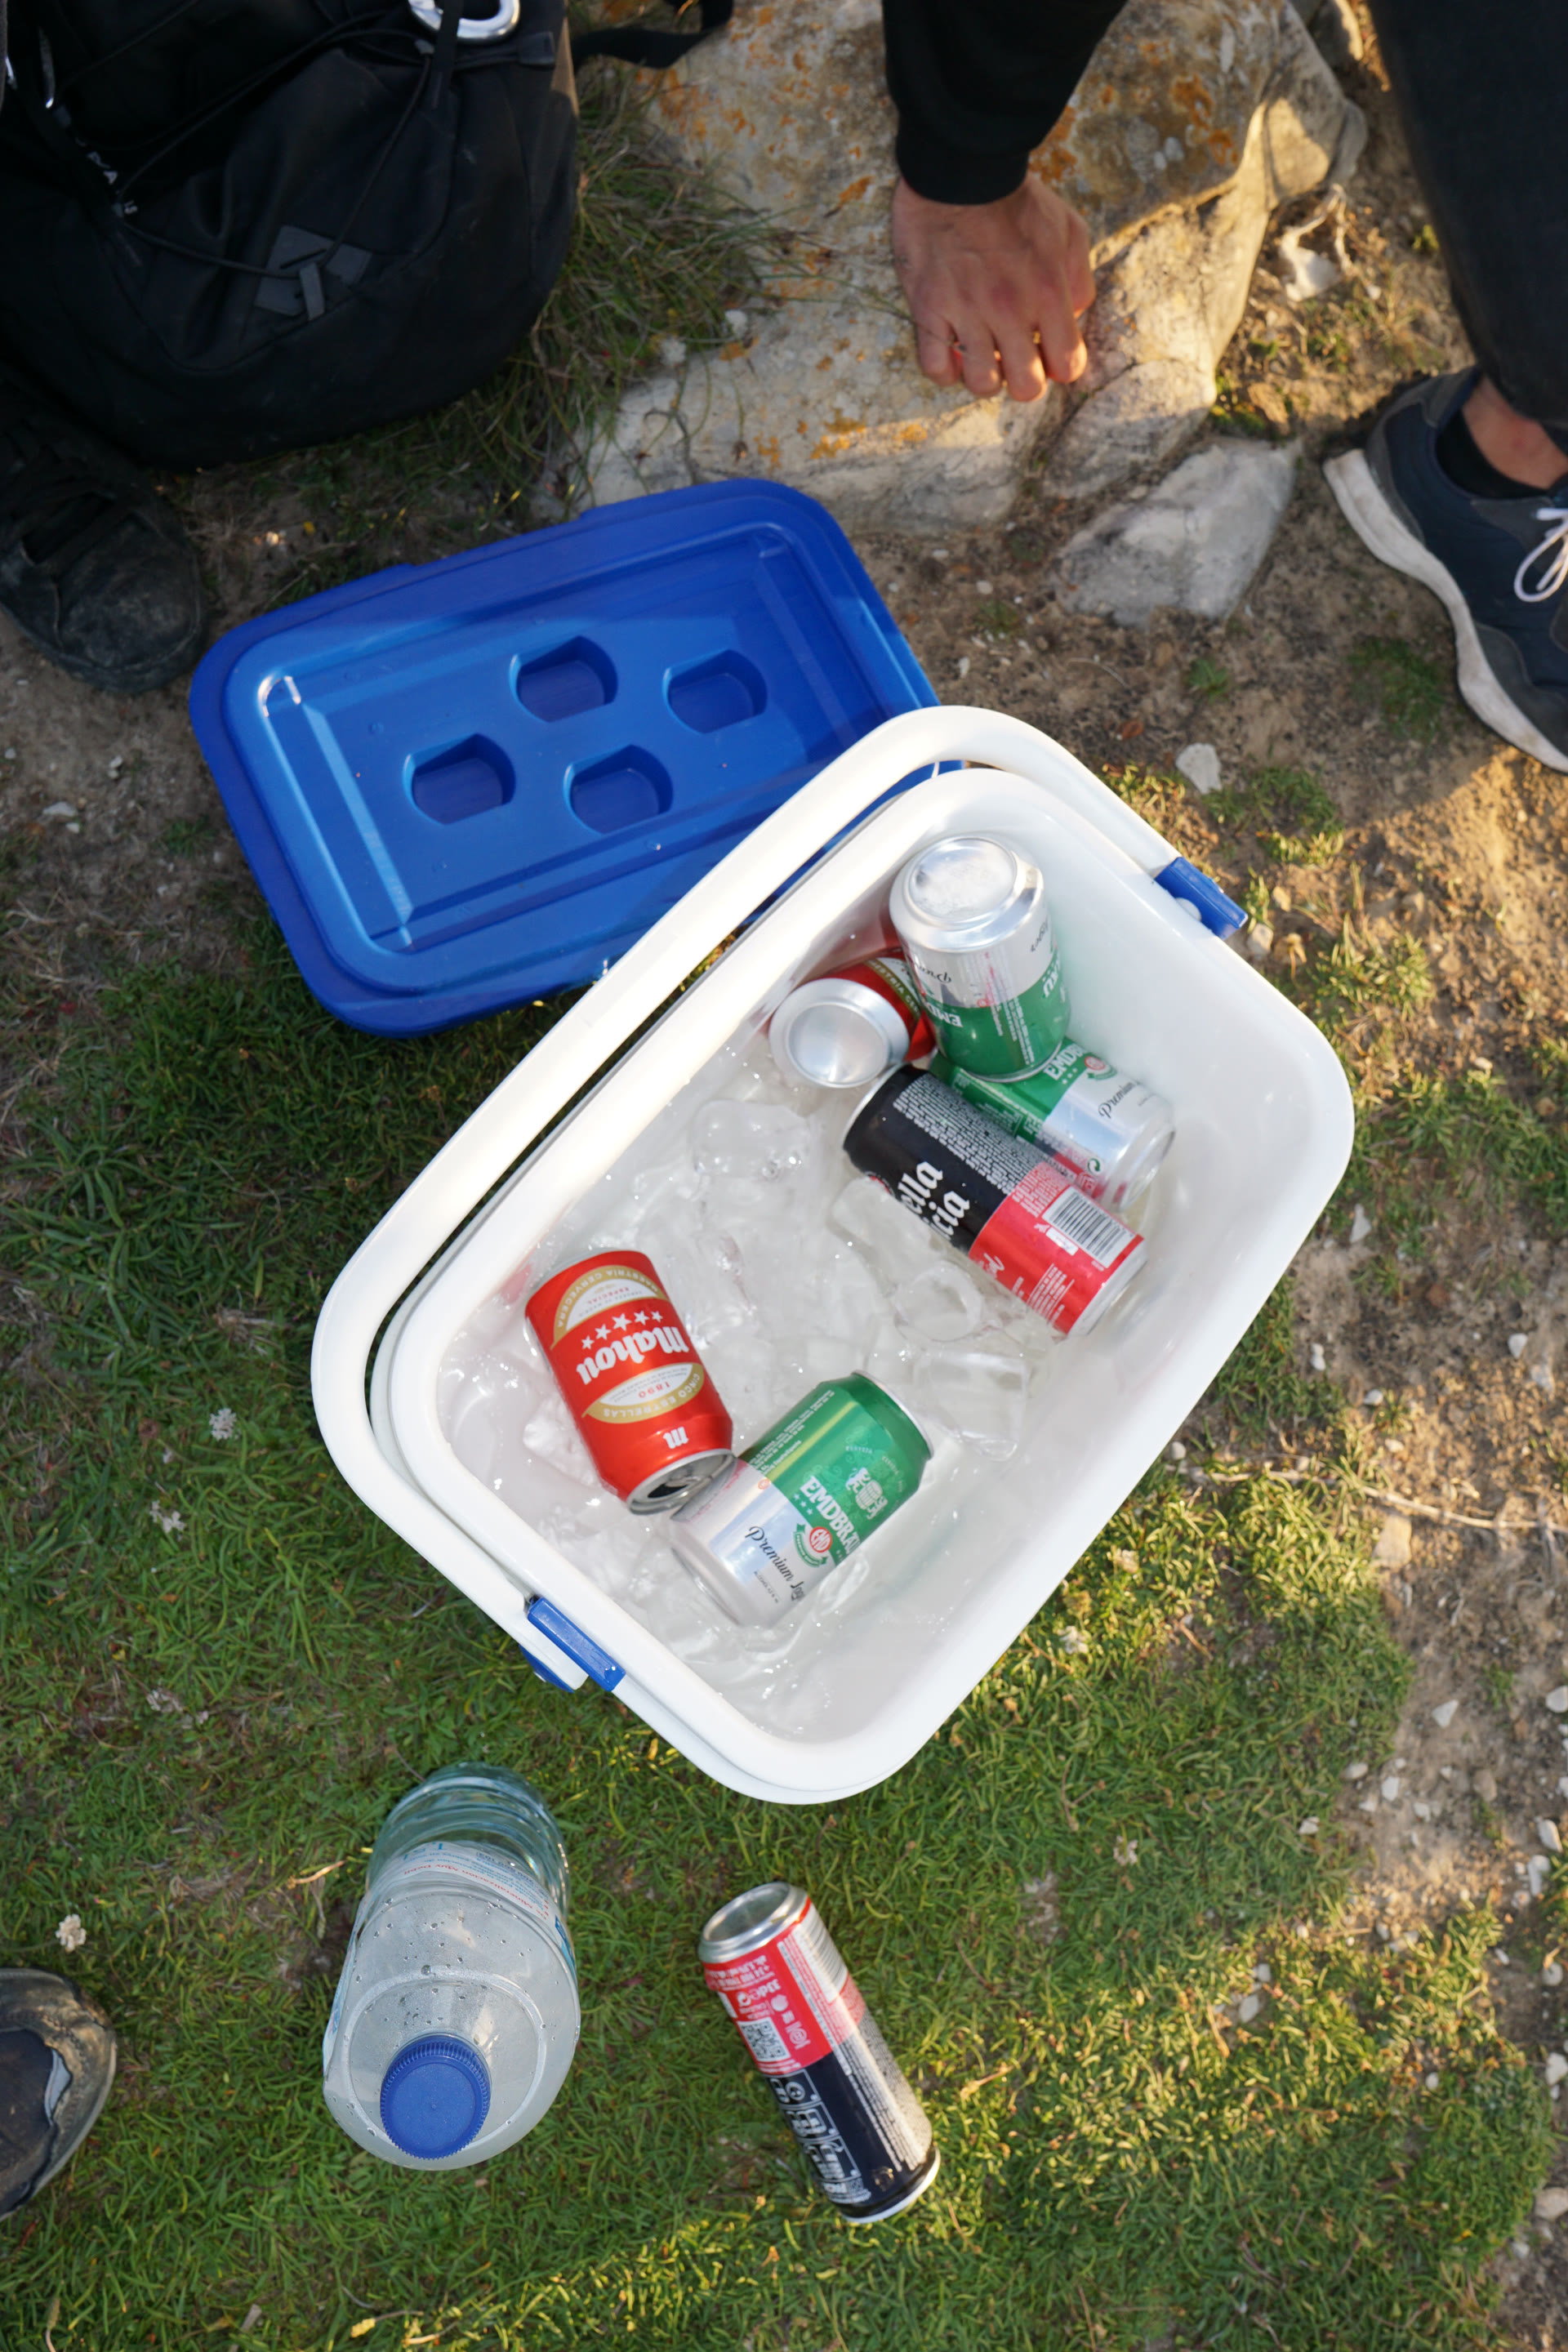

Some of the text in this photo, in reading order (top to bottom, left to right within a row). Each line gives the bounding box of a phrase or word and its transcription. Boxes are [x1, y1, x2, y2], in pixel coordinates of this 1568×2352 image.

[637, 1381, 670, 1398] 1890
[677, 1372, 699, 1398] CINCO
[603, 1395, 676, 1417] ESTRELLAS
[811, 1528, 831, 1550] EMD
[744, 1527, 794, 1582] Premium
